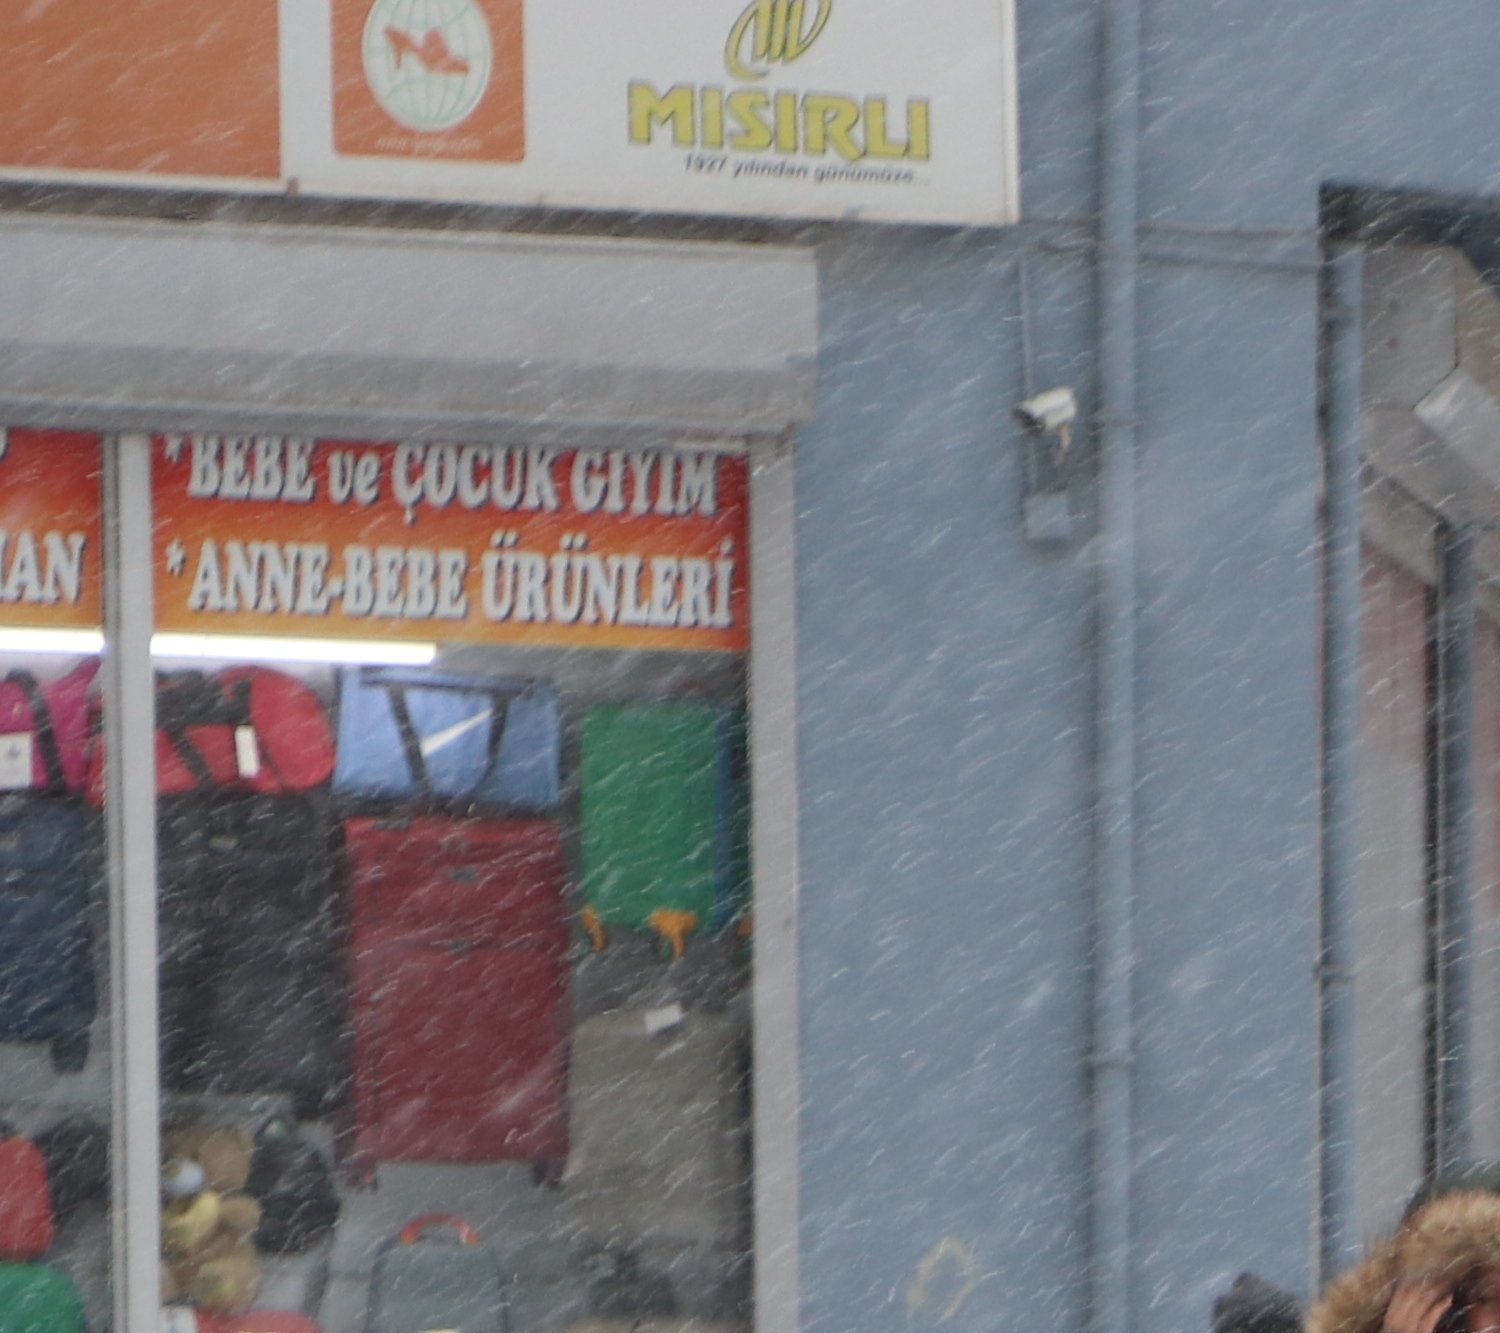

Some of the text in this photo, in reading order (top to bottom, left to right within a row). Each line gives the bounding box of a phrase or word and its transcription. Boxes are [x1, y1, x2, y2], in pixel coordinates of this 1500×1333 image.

[188, 434, 316, 502] BEBE
[328, 450, 381, 505] ve
[391, 441, 560, 527] ÇOCUK
[188, 528, 735, 629] ANNE-BEBE ÜRÜNLERİ
